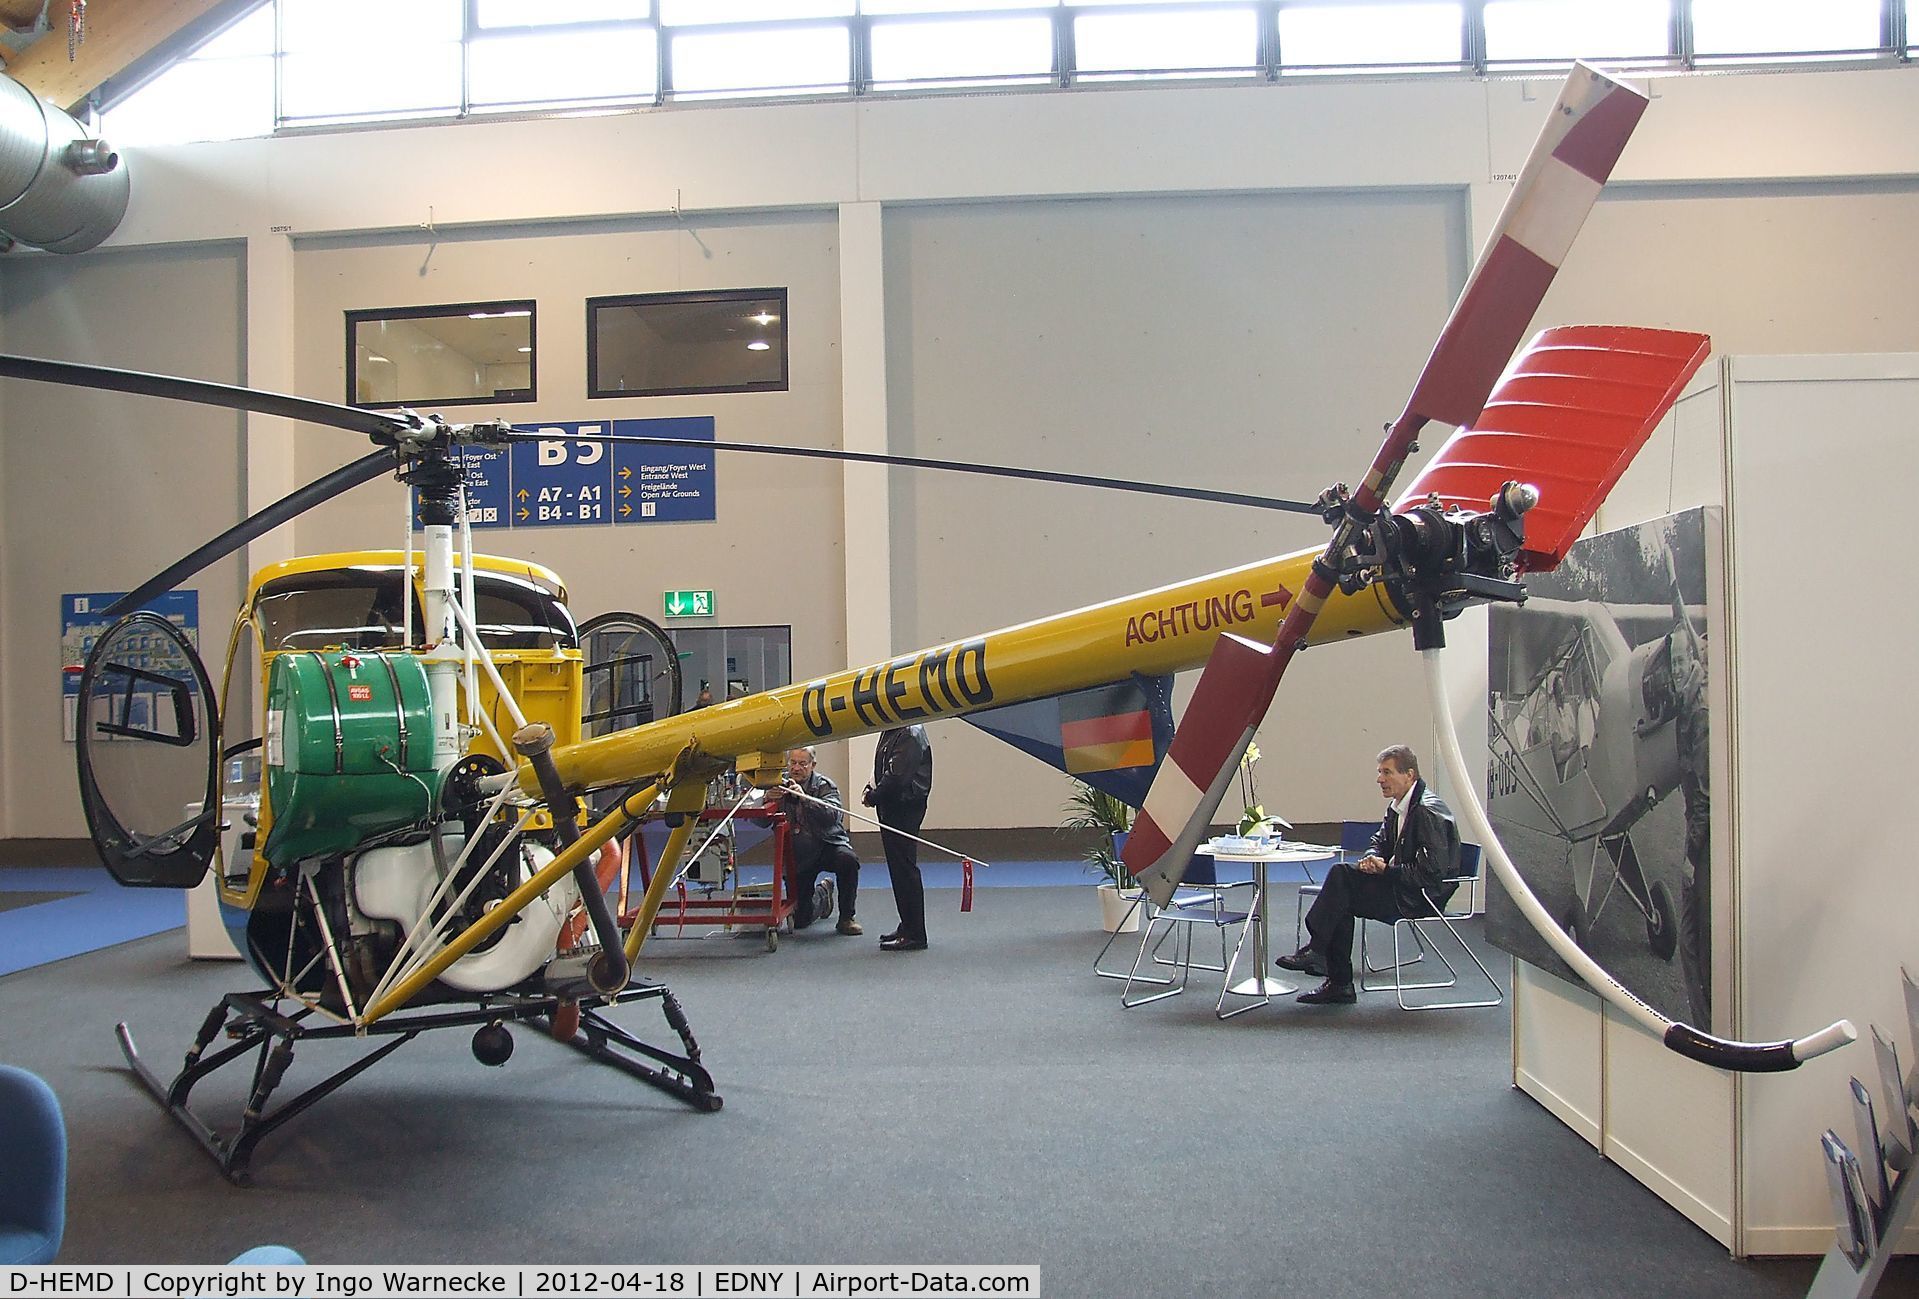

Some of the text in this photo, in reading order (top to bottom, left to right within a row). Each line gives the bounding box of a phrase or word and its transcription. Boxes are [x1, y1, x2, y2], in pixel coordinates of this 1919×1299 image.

[641, 463, 706, 473] Eingang/Foyer West
[475, 479, 489, 487] East
[641, 482, 677, 491] Freigelände
[538, 487, 562, 502] A7
[578, 485, 601, 501] A1
[641, 490, 700, 500] Open Air Grounds
[539, 505, 561, 521] B4
[580, 504, 601, 519] B1
[1125, 590, 1255, 648] ACHTUNG
[802, 638, 994, 737] D-HEMD
